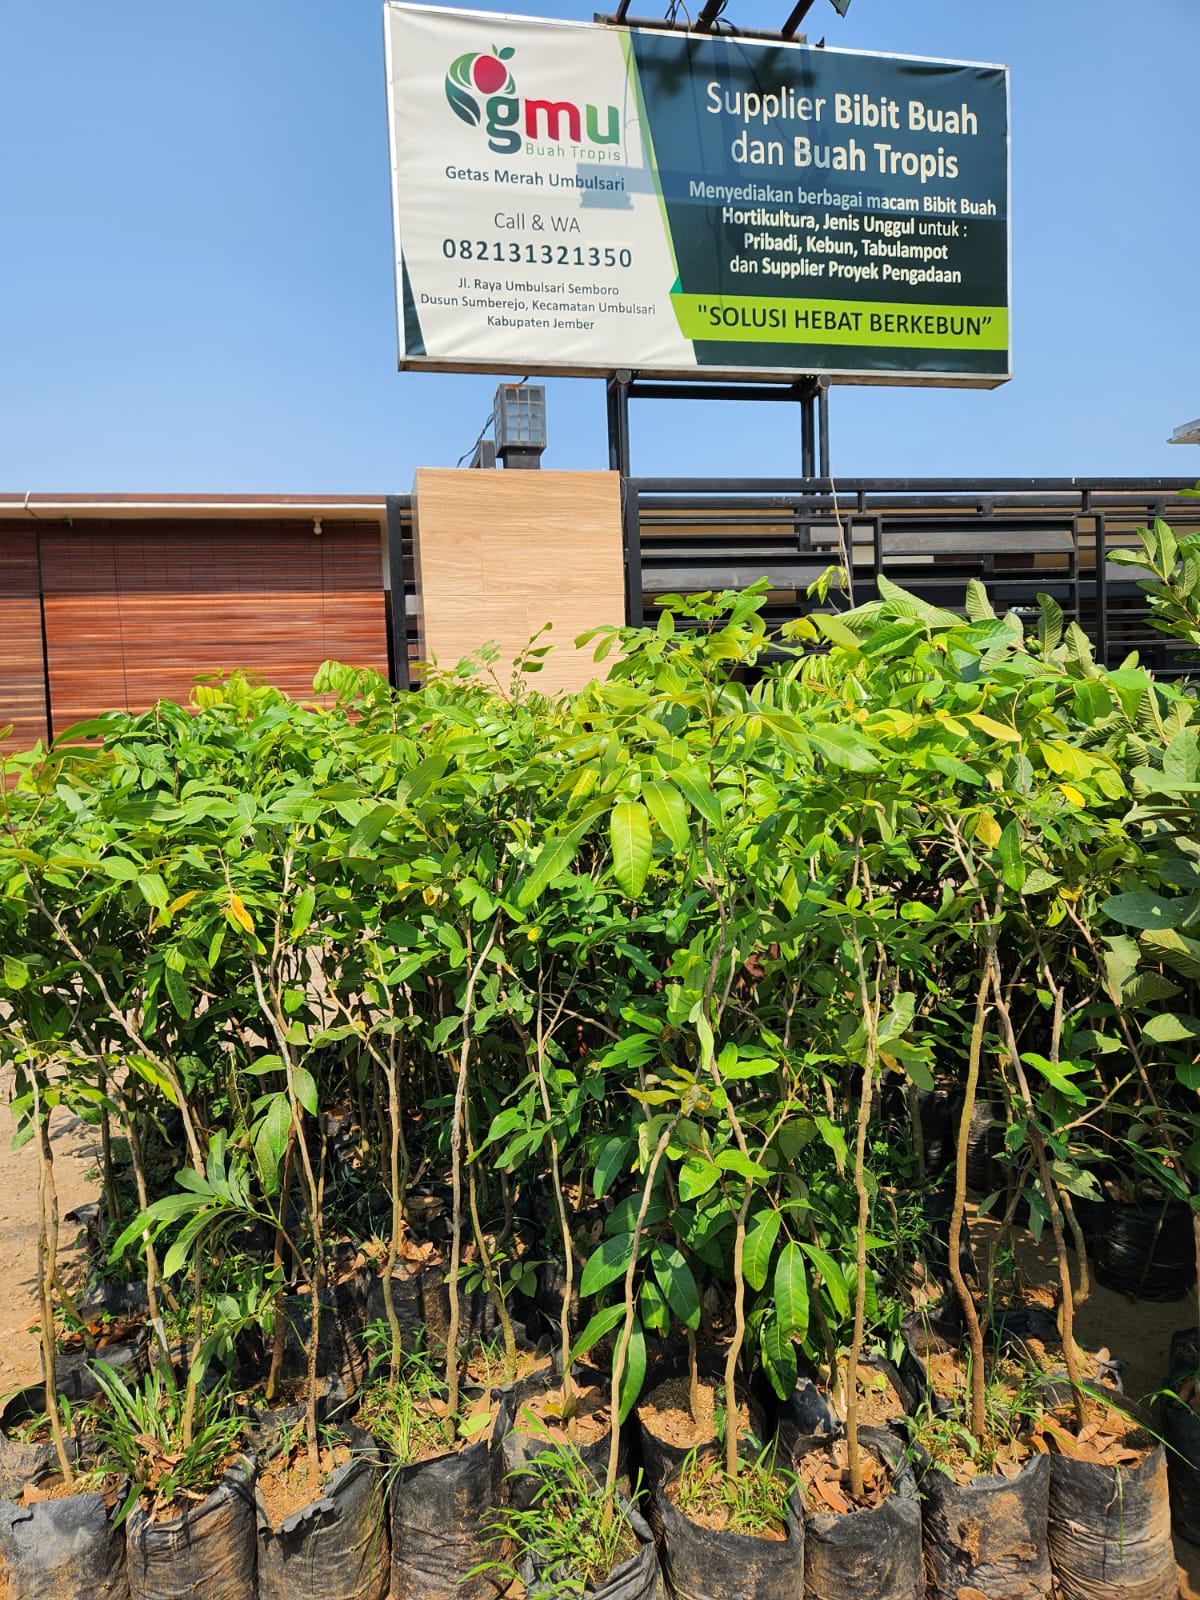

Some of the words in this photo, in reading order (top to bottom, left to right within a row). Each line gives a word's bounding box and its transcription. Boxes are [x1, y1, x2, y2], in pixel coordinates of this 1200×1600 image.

[706, 82, 826, 125] Supplier
[834, 93, 900, 129] Bibit
[909, 101, 978, 135] Buah
[486, 96, 620, 154] gmu
[526, 143, 565, 158] Buah
[570, 146, 621, 162] Tropis
[731, 131, 784, 166] dan
[794, 136, 866, 172] Buah
[874, 143, 959, 183] Tropis
[445, 166, 489, 182] Getas
[494, 170, 544, 186] Merah
[549, 173, 625, 191] Umbulsari
[690, 181, 793, 204] Menyediakan
[798, 187, 862, 210] berbagai
[867, 194, 919, 211] macam
[923, 197, 957, 214] Bibit
[961, 199, 996, 215] Buah
[494, 213, 525, 230] Call
[531, 215, 545, 231] &
[550, 216, 581, 233] WA
[722, 207, 819, 230] Hortikultura,
[823, 214, 860, 231] Jenis
[864, 216, 914, 237] Unggul
[919, 221, 959, 237] untuk
[442, 239, 632, 268] 082131321350
[744, 233, 802, 254] Pribadi,
[807, 236, 858, 257] Kebun,
[861, 239, 948, 261] Tabulampot
[730, 256, 758, 273] dan
[762, 258, 825, 279] Supplier
[828, 261, 879, 282] Proyek
[882, 266, 961, 285] Pengadaan
[458, 278, 471, 289] Jl.
[475, 279, 502, 293] Raya
[505, 281, 565, 294] Umbulsari
[568, 284, 619, 295] Semboro
[420, 294, 459, 306] Dusun
[462, 296, 529, 312] Sumberejo,
[532, 300, 595, 313] Kecamatan
[599, 302, 656, 315] Umbulsari
[487, 316, 550, 330] Kabupaten
[553, 318, 595, 330] Jember
[795, 310, 862, 331] HEBAT
